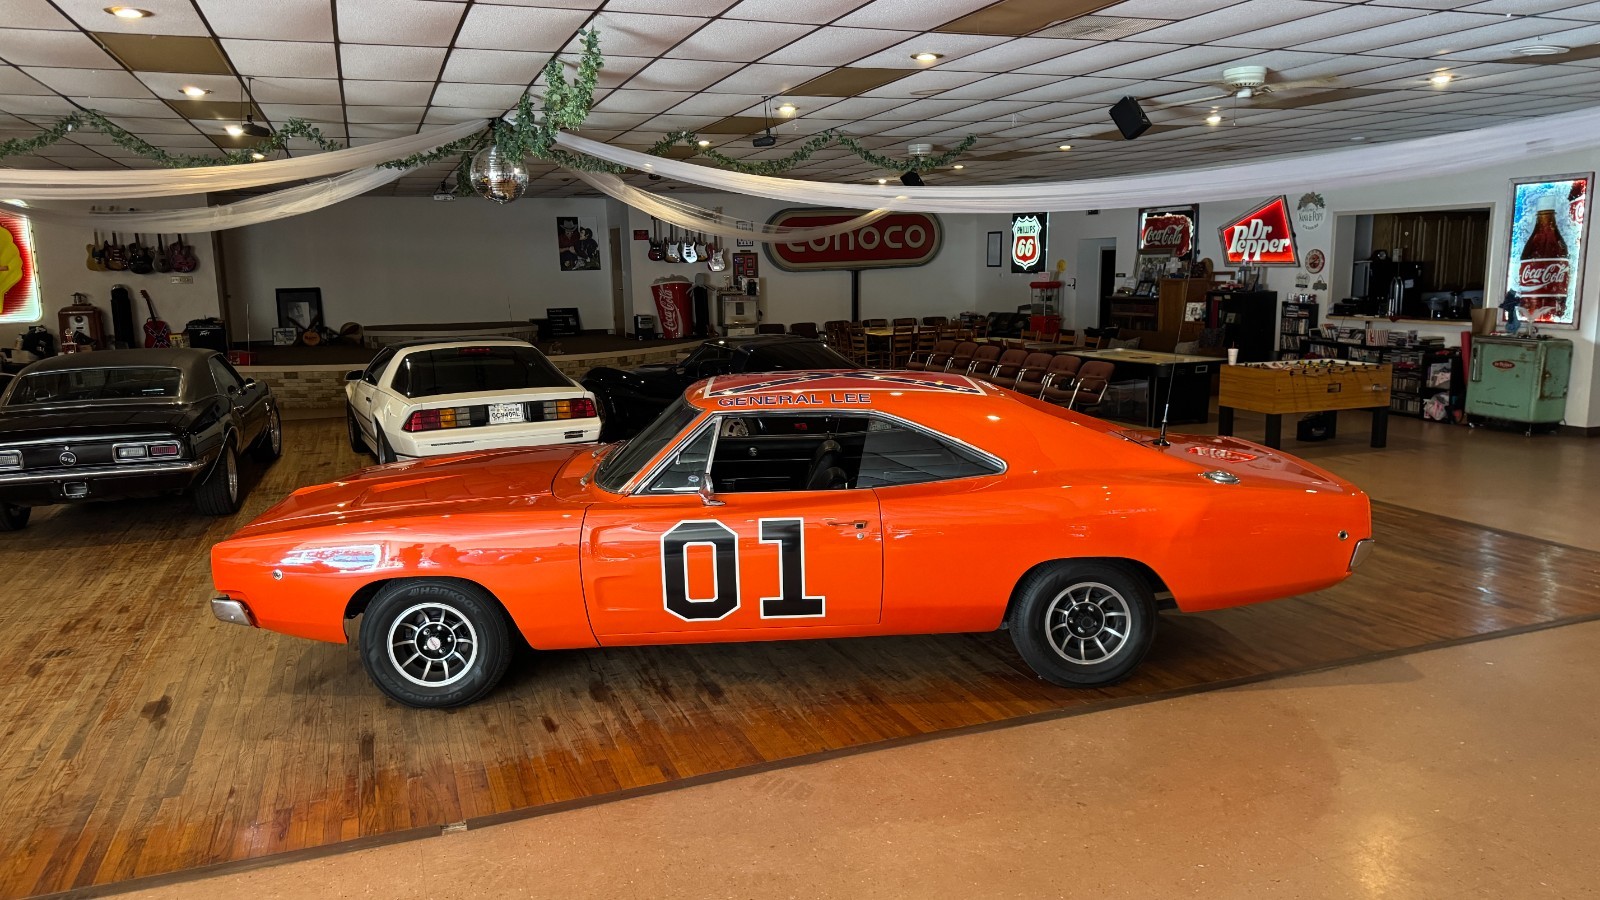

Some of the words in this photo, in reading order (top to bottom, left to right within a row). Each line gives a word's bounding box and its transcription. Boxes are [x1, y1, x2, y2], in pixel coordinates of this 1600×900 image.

[1016, 225, 1036, 235] PHILLIPS
[1247, 219, 1273, 240] Dr
[1017, 238, 1034, 257] 66
[1228, 226, 1290, 261] Pepper
[1521, 263, 1570, 284] Coca-Cola
[659, 287, 677, 331] Coca-Cola
[718, 394, 824, 408] GENERAL
[830, 393, 872, 404] LEE
[660, 517, 826, 622] 01
